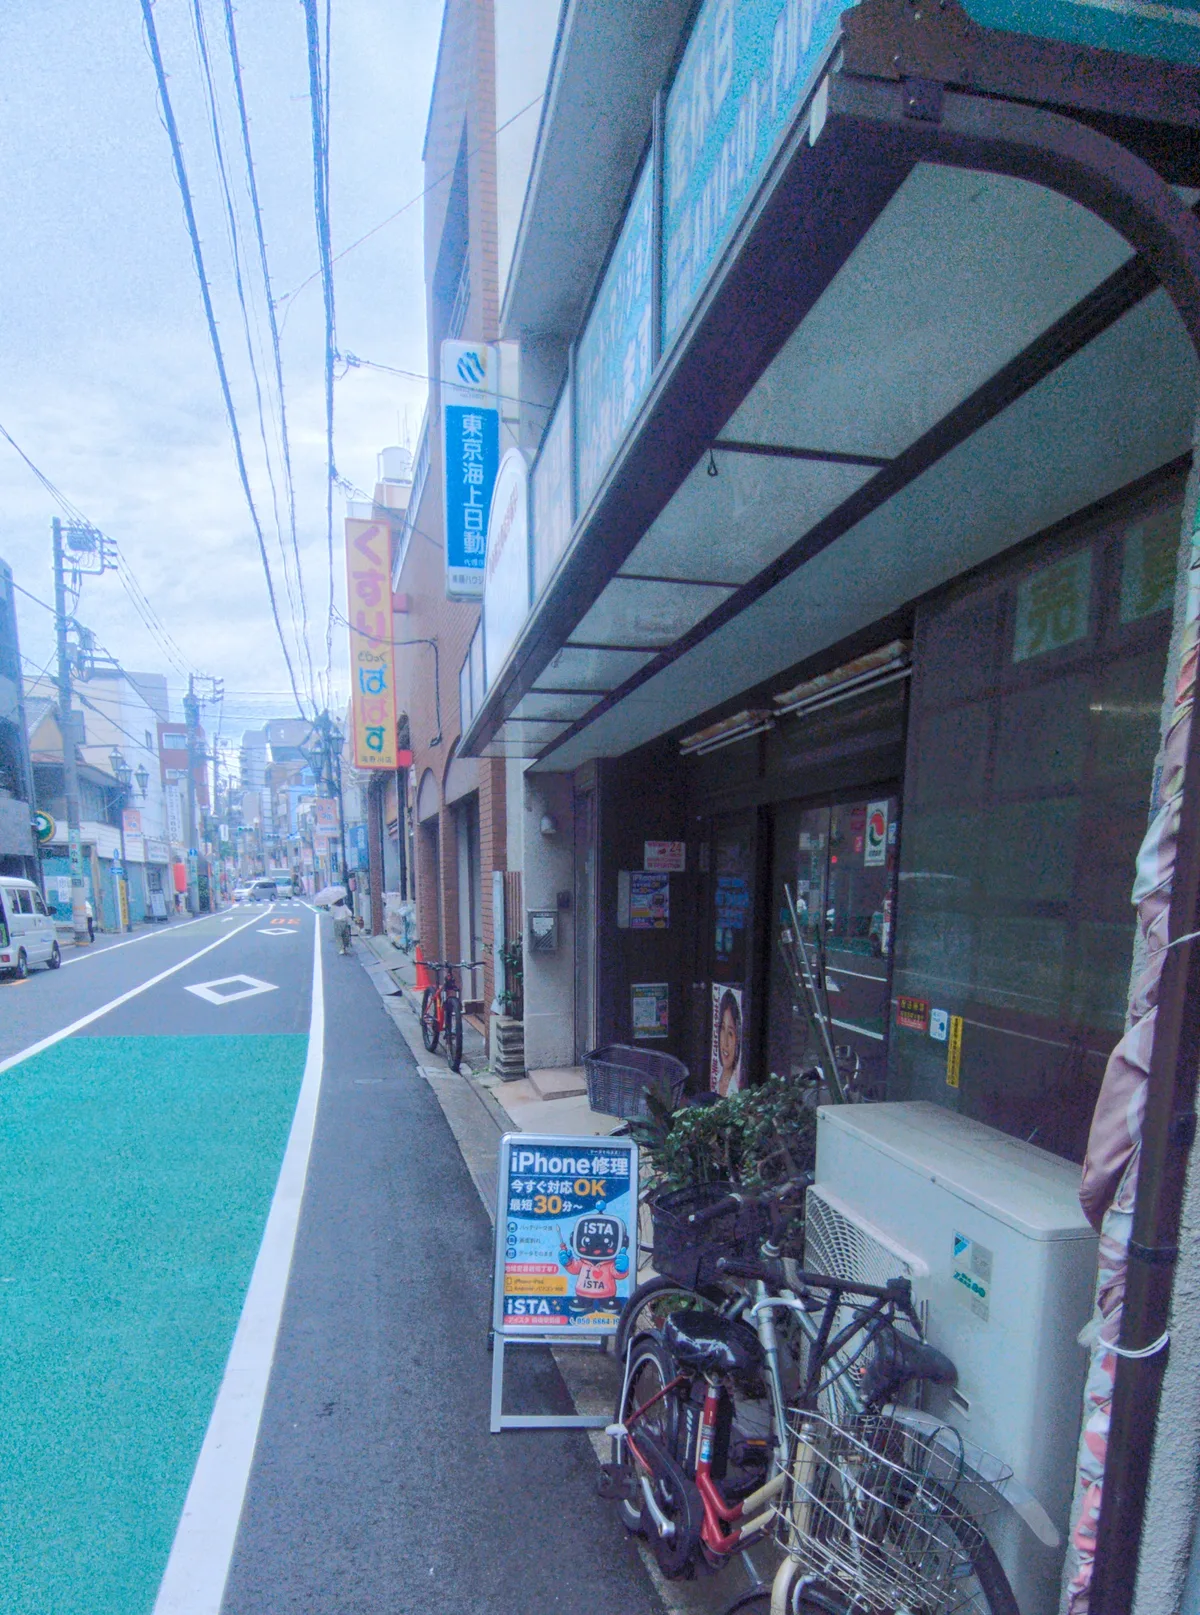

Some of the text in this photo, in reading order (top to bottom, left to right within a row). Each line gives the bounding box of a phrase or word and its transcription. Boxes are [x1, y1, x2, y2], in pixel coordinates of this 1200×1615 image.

[462, 414, 486, 554] 東京海上日動
[352, 526, 386, 649] くすり
[511, 1151, 628, 1175] iPhone修理
[510, 1179, 606, 1197] 今すぐ対応OK
[584, 1222, 614, 1236] iSTA
[583, 1280, 605, 1290] iSTA
[507, 1298, 550, 1315] iSTA
